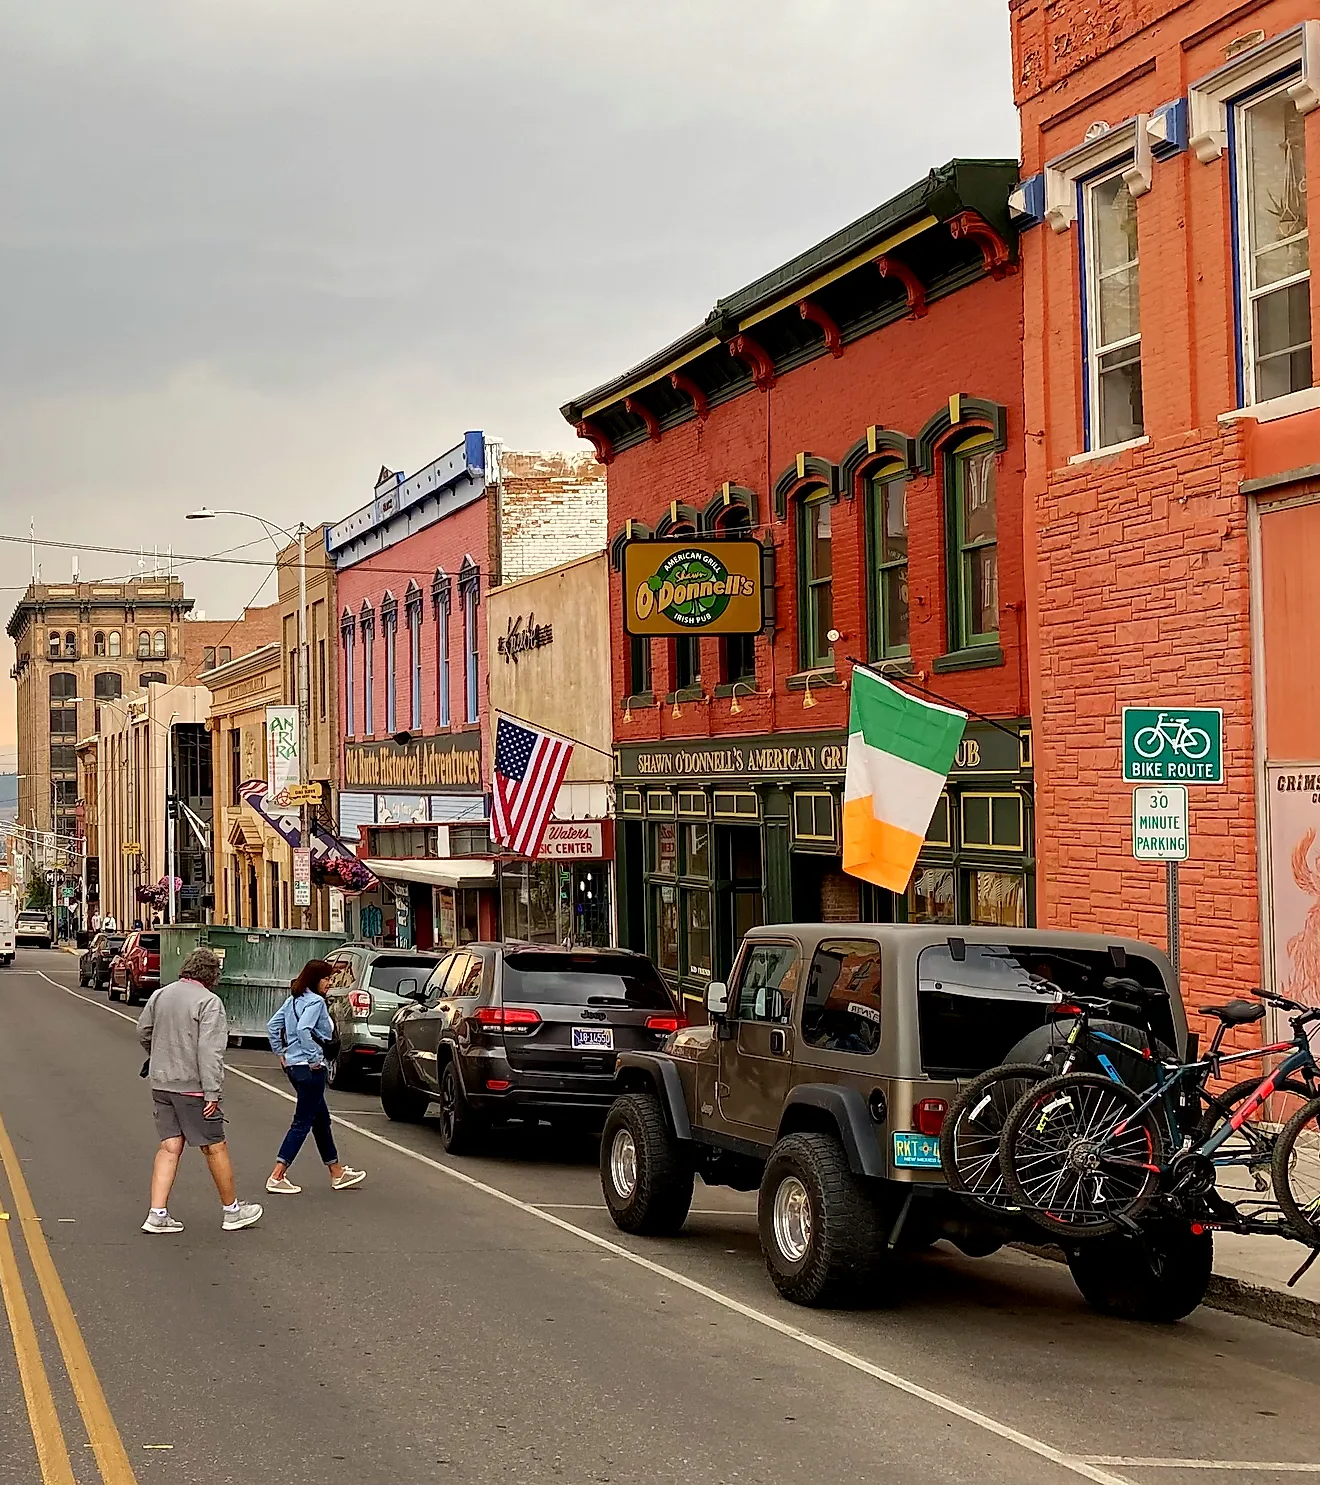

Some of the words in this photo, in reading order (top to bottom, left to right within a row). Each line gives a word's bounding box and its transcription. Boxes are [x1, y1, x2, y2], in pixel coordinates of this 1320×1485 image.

[663, 552, 702, 572] AMERICAN
[702, 555, 722, 574] GRILL
[675, 570, 707, 582] Shawn
[636, 574, 755, 620] O'Donnell's
[674, 612, 694, 624] IRISH
[696, 612, 712, 624] PUB
[346, 748, 358, 784] Old
[359, 748, 379, 785] Butte
[380, 745, 420, 785] Historical
[422, 743, 479, 785] Adventures
[637, 753, 672, 774] SHAWN
[675, 749, 744, 773] O'DONNELL'S
[747, 747, 816, 771] AMERICAN
[821, 746, 847, 770] GRI
[955, 740, 981, 767] UB
[1132, 762, 1162, 777] BIKE
[1168, 762, 1213, 778] ROUTE
[1149, 795, 1168, 809] 30
[1139, 816, 1180, 830] MINUTE
[549, 826, 592, 840] Waters
[540, 844, 552, 854] SIC
[556, 843, 592, 854] CENTER
[1137, 837, 1185, 851] PARKING
[896, 1140, 918, 1156] RKT
